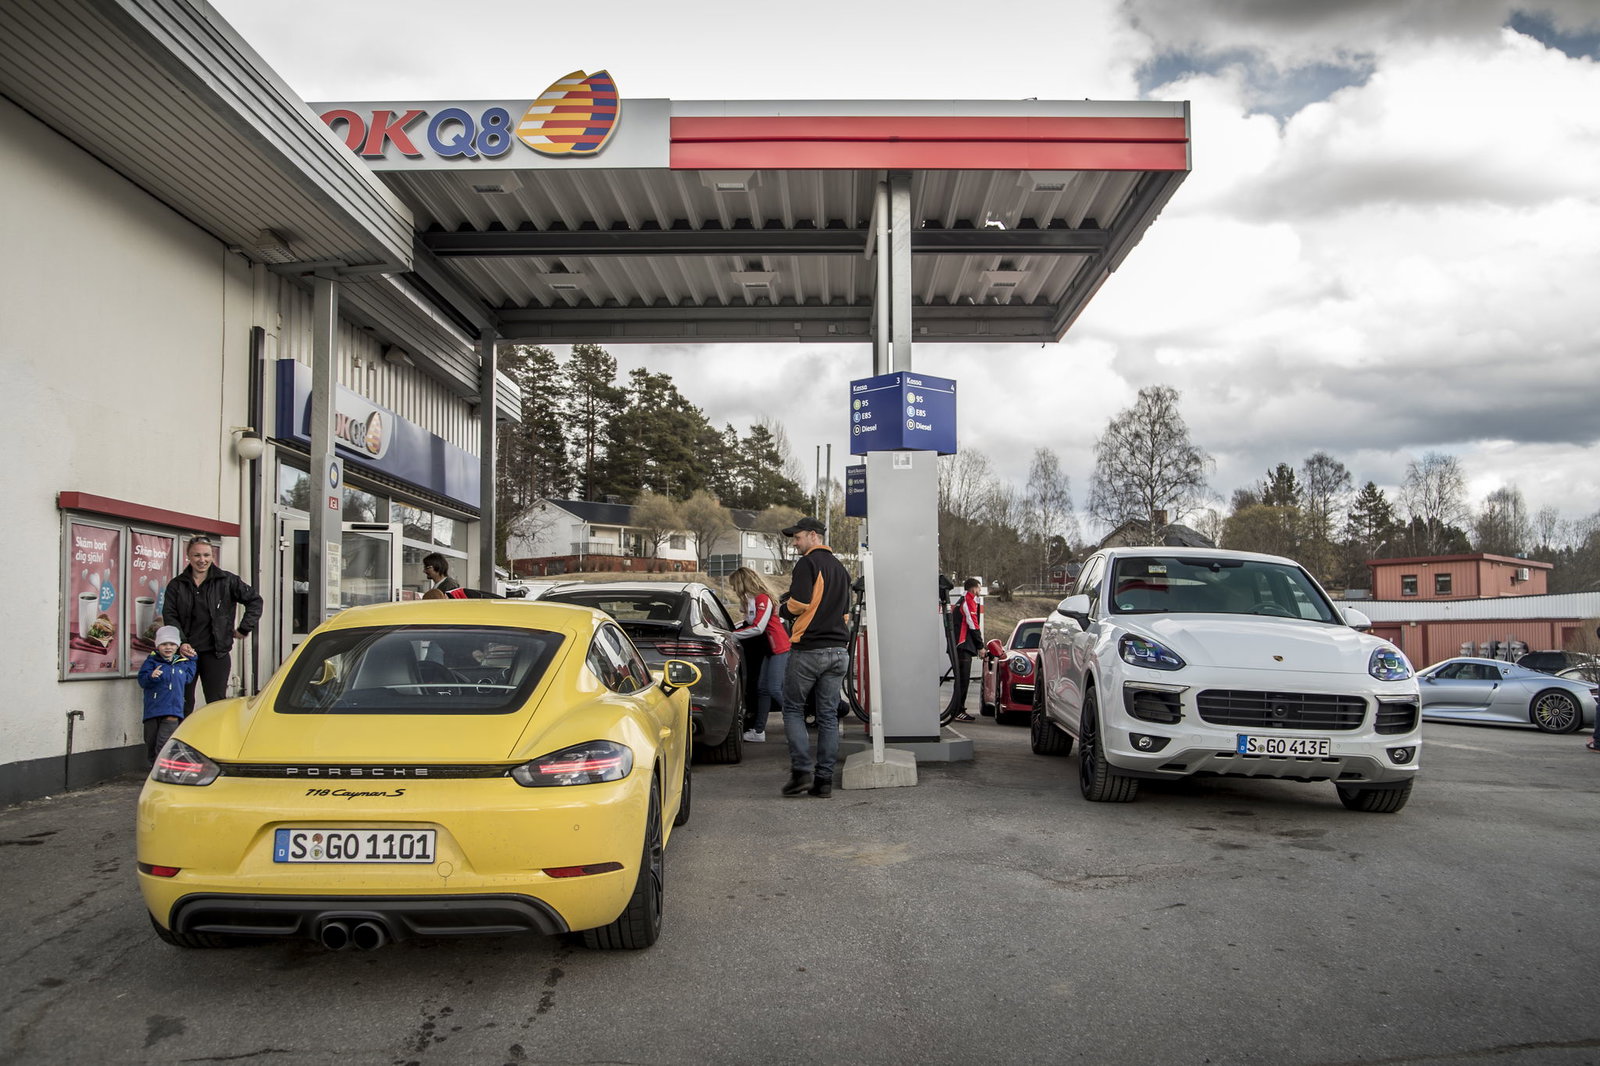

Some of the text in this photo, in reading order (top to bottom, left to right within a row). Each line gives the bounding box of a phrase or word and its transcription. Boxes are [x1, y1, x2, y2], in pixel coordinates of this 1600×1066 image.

[318, 107, 513, 158] OKQ8
[906, 377, 922, 386] Kassa
[853, 384, 868, 392] Kassa
[862, 399, 869, 407] 95
[916, 395, 924, 403] 95
[862, 411, 872, 420] E85
[916, 409, 926, 417] E85
[862, 424, 877, 432] Diesel
[916, 422, 932, 431] Diesel
[75, 536, 107, 551] Skäm bort
[75, 550, 104, 565] dig själv!
[133, 557, 147, 571] dig
[1247, 738, 1257, 752] S
[1266, 739, 1286, 754] GO
[1289, 740, 1329, 755] 413E
[286, 767, 428, 776] PORSCHE
[305, 788, 406, 800] 718 Cayman S
[278, 833, 431, 859] D S GO 1101
